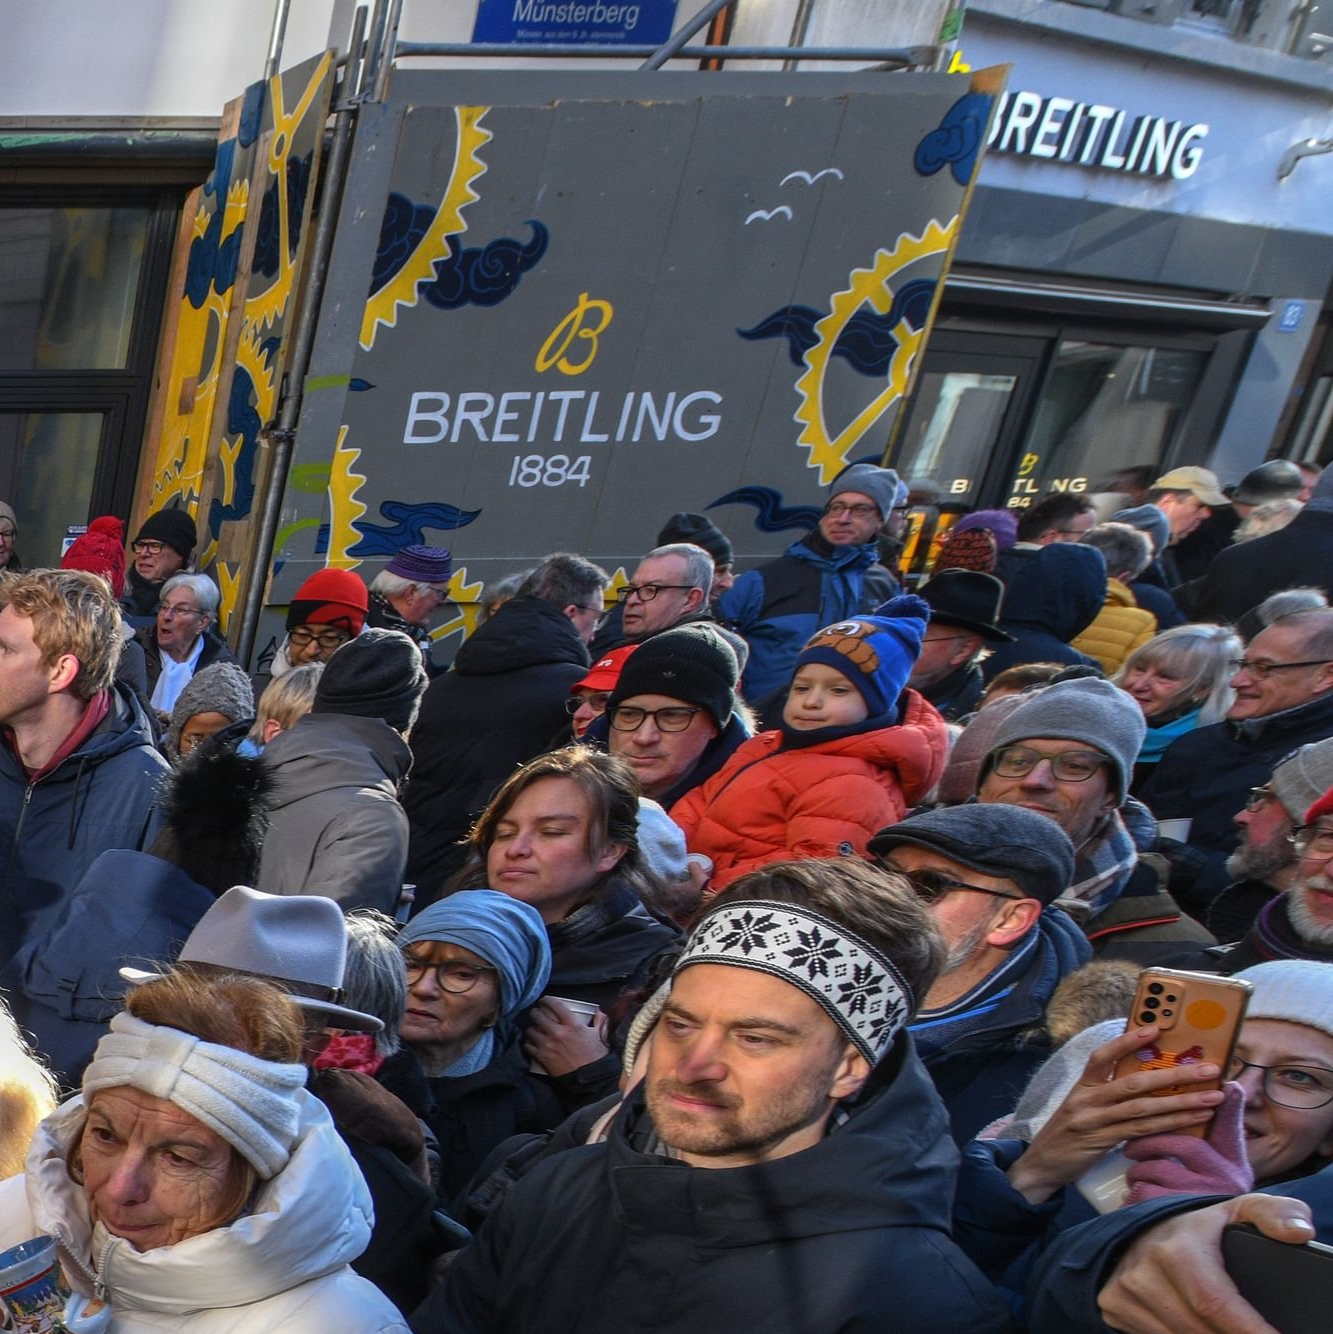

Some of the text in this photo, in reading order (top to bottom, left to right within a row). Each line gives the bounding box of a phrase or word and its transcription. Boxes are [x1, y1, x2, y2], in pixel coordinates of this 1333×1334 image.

[512, 0, 640, 30] Münsterberg
[403, 390, 724, 444] BREITLING
[508, 454, 592, 487] 1884
